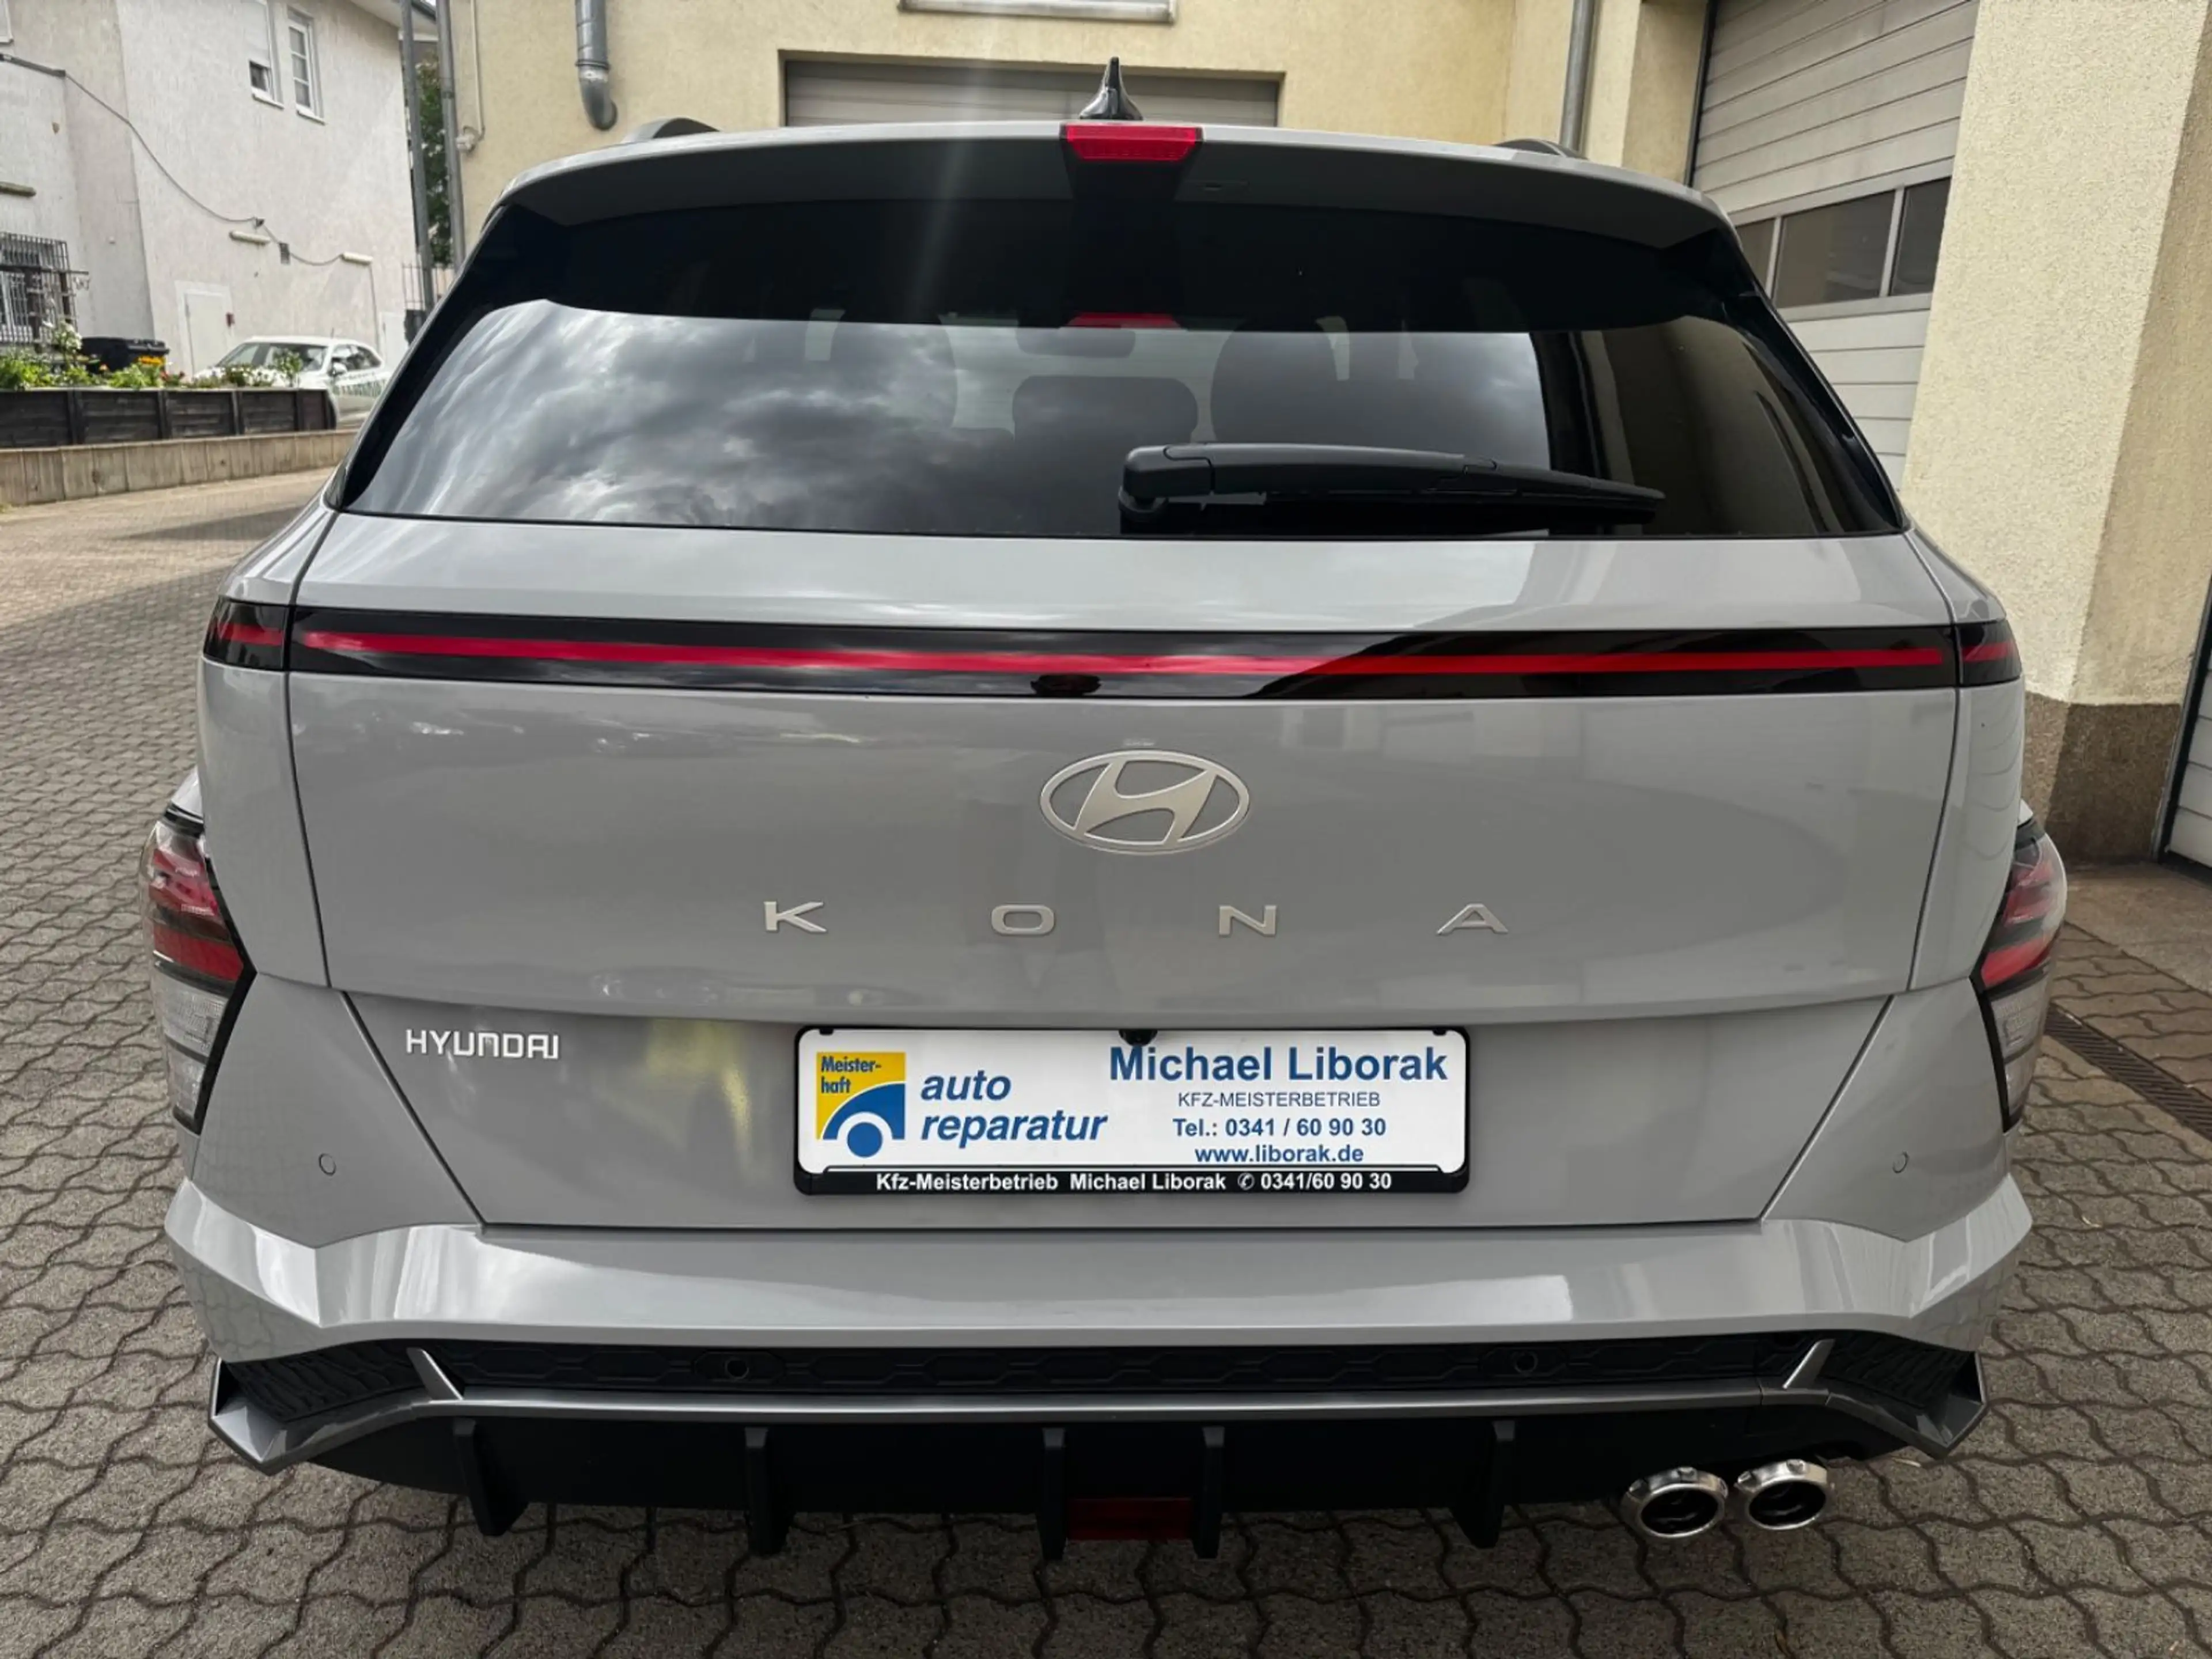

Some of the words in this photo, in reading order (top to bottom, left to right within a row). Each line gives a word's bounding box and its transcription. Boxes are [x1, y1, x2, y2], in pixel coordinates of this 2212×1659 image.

[762, 900, 1509, 938] KONA
[405, 1029, 560, 1060] HYUNDAI
[821, 1056, 882, 1073] Meister-
[1110, 1046, 1272, 1081] Michael
[1289, 1046, 1448, 1081] Liborak
[821, 1077, 851, 1094] haft
[922, 1070, 1012, 1100] auto
[1178, 1092, 1380, 1107] KFZ-MEISTERBETRIEB
[921, 1110, 1108, 1149] reparatur
[1173, 1118, 1218, 1137] Tel.:
[1225, 1118, 1274, 1137] 0341
[1283, 1118, 1289, 1137] /
[1297, 1118, 1322, 1137] 60
[1329, 1118, 1354, 1137] 90
[1361, 1118, 1386, 1137] 30
[1195, 1145, 1363, 1162] www.liborak.de
[876, 1174, 1058, 1191] Kfz-Meisterbetrieb
[1070, 1174, 1145, 1190] Michael
[1153, 1174, 1226, 1190] Liborak
[1261, 1173, 1334, 1190] 0341/60
[1340, 1173, 1363, 1190] 90
[1369, 1173, 1392, 1190] 30
